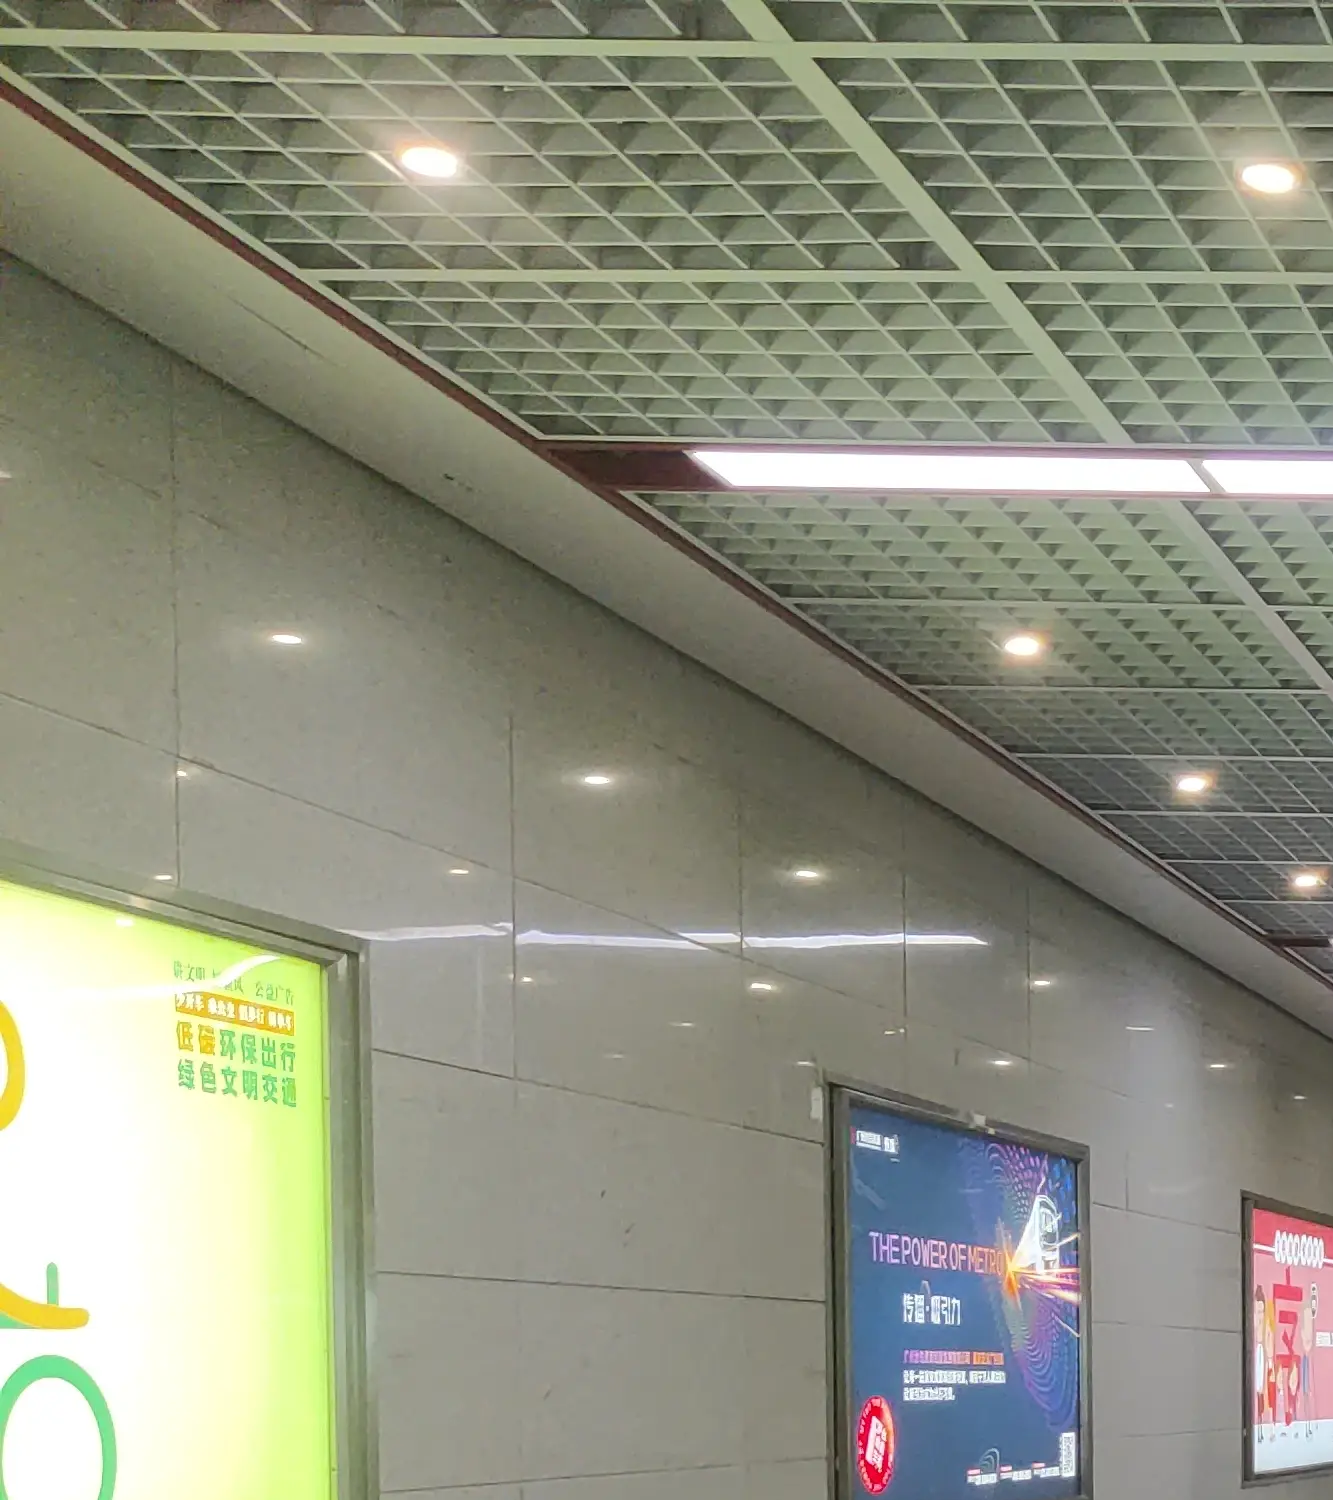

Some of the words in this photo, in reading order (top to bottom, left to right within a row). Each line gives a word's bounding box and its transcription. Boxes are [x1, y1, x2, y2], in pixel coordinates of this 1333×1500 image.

[176, 1019, 296, 1073] 低碳环保出行
[177, 1058, 297, 1108] 绿色文明交通
[869, 1231, 900, 1264] THE
[901, 1237, 949, 1270] POWER
[950, 1242, 967, 1271] OF
[967, 1245, 1006, 1277] METRO
